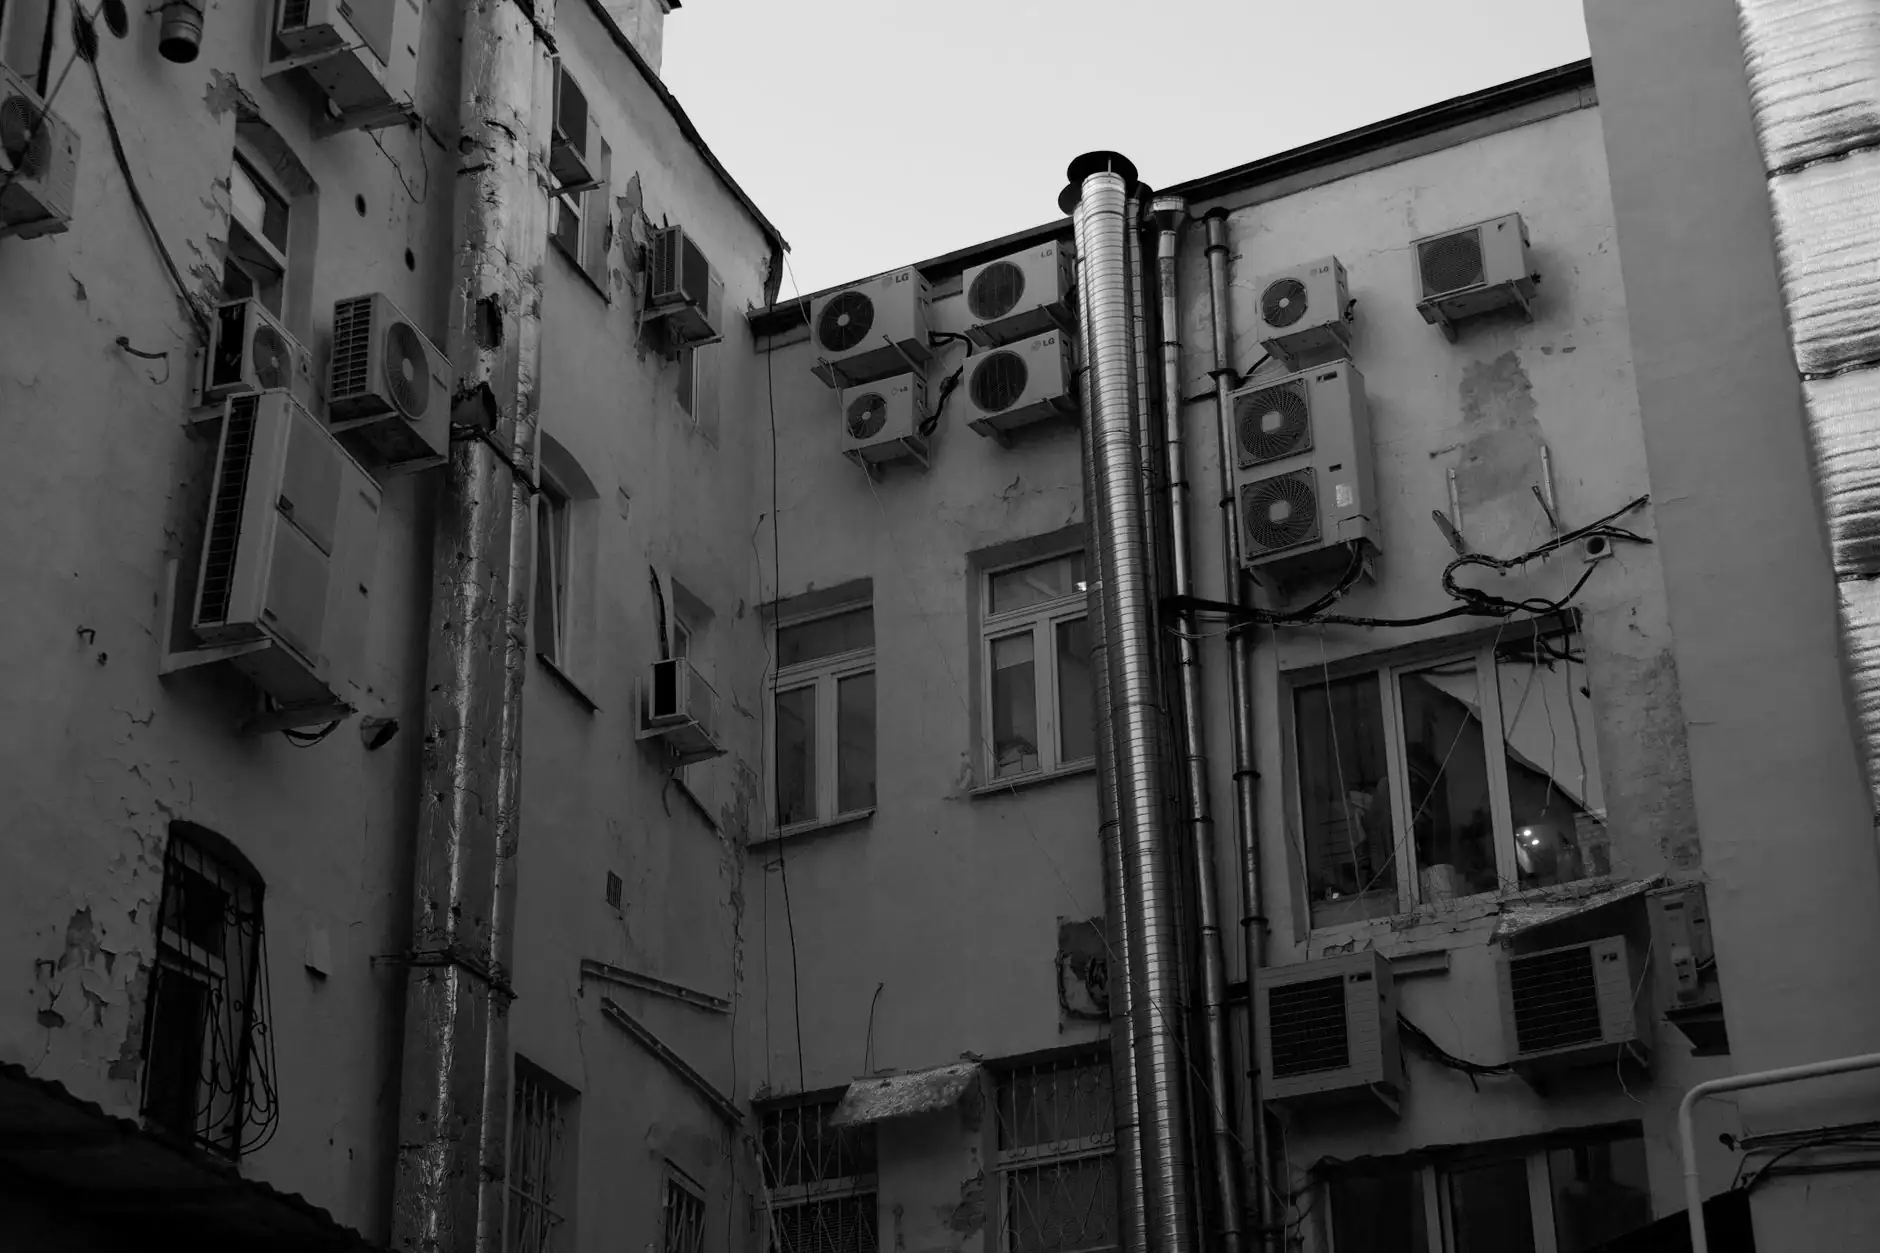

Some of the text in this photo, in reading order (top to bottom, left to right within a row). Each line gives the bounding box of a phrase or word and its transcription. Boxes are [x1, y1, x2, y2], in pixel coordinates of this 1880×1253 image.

[1041, 249, 1052, 258] LG
[1319, 266, 1328, 274] LG
[896, 273, 909, 283] LG
[1043, 337, 1055, 346] LG
